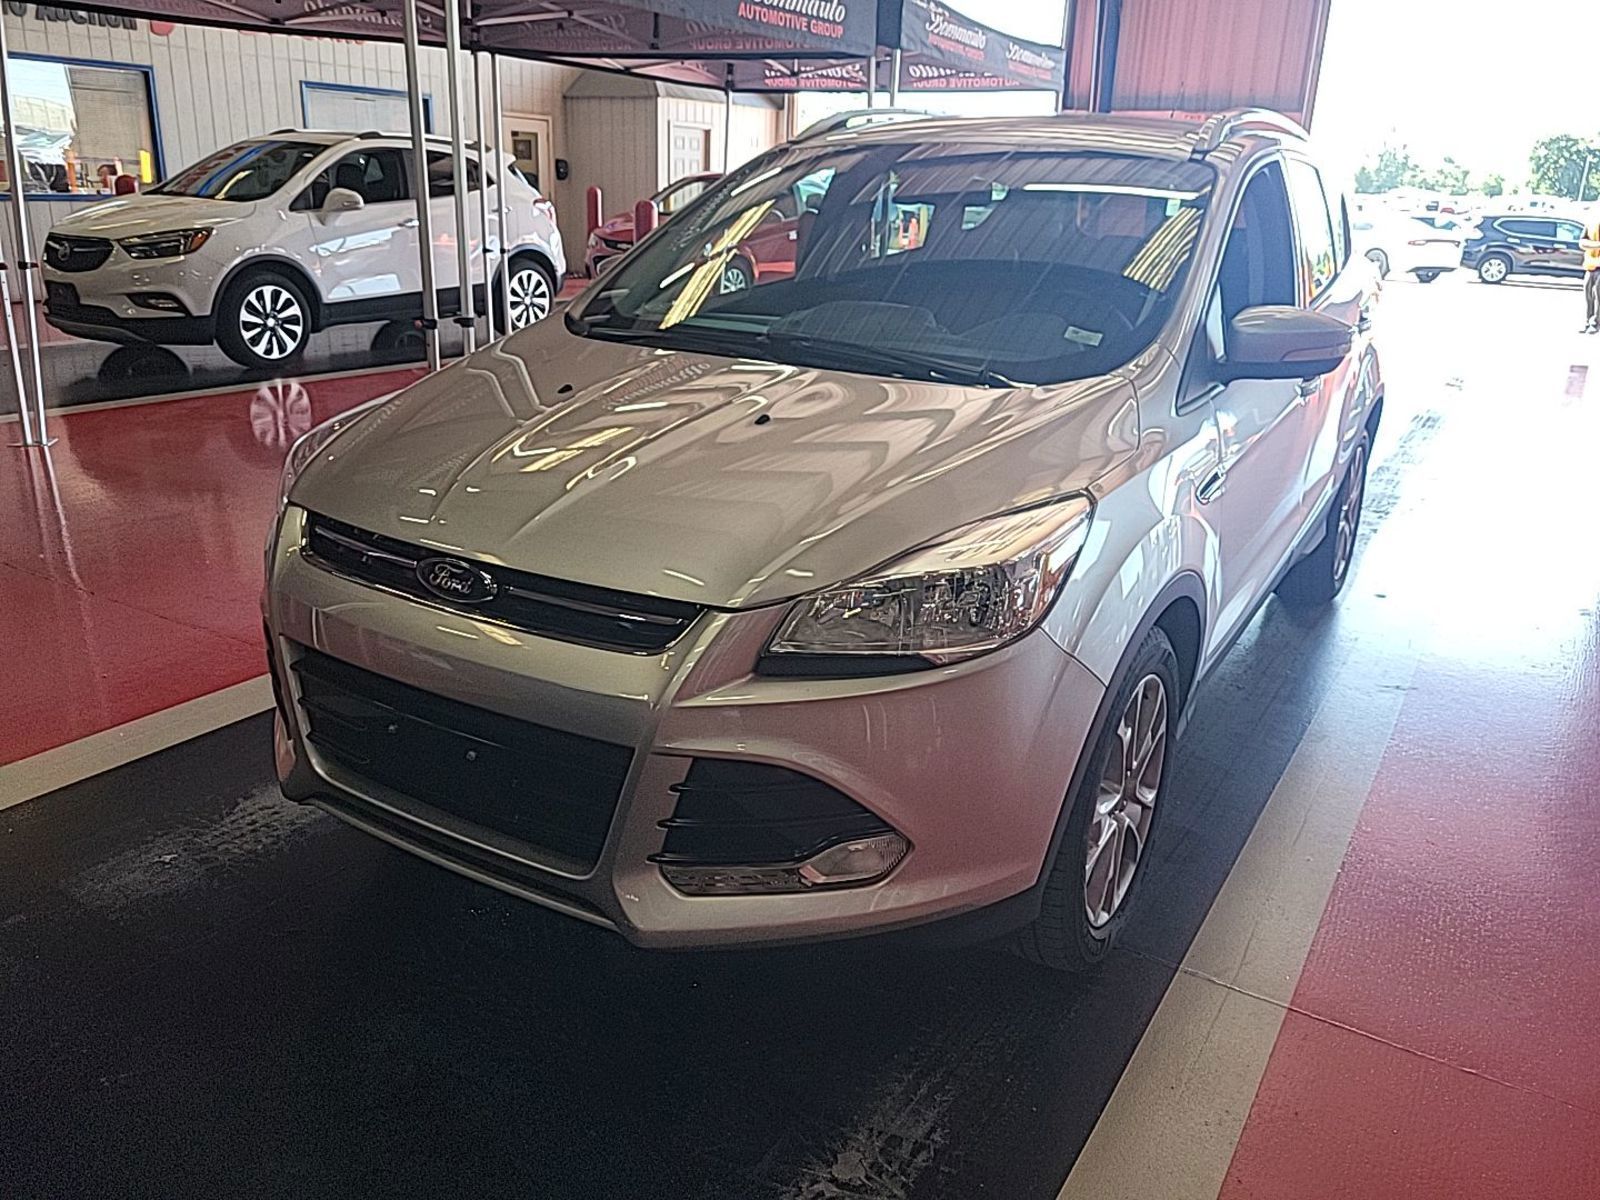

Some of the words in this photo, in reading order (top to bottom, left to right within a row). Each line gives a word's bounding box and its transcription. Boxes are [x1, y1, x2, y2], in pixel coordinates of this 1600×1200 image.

[738, 2, 808, 31] AUTOMOTIVE
[810, 19, 844, 39] GROUP
[429, 563, 475, 595] Ford
